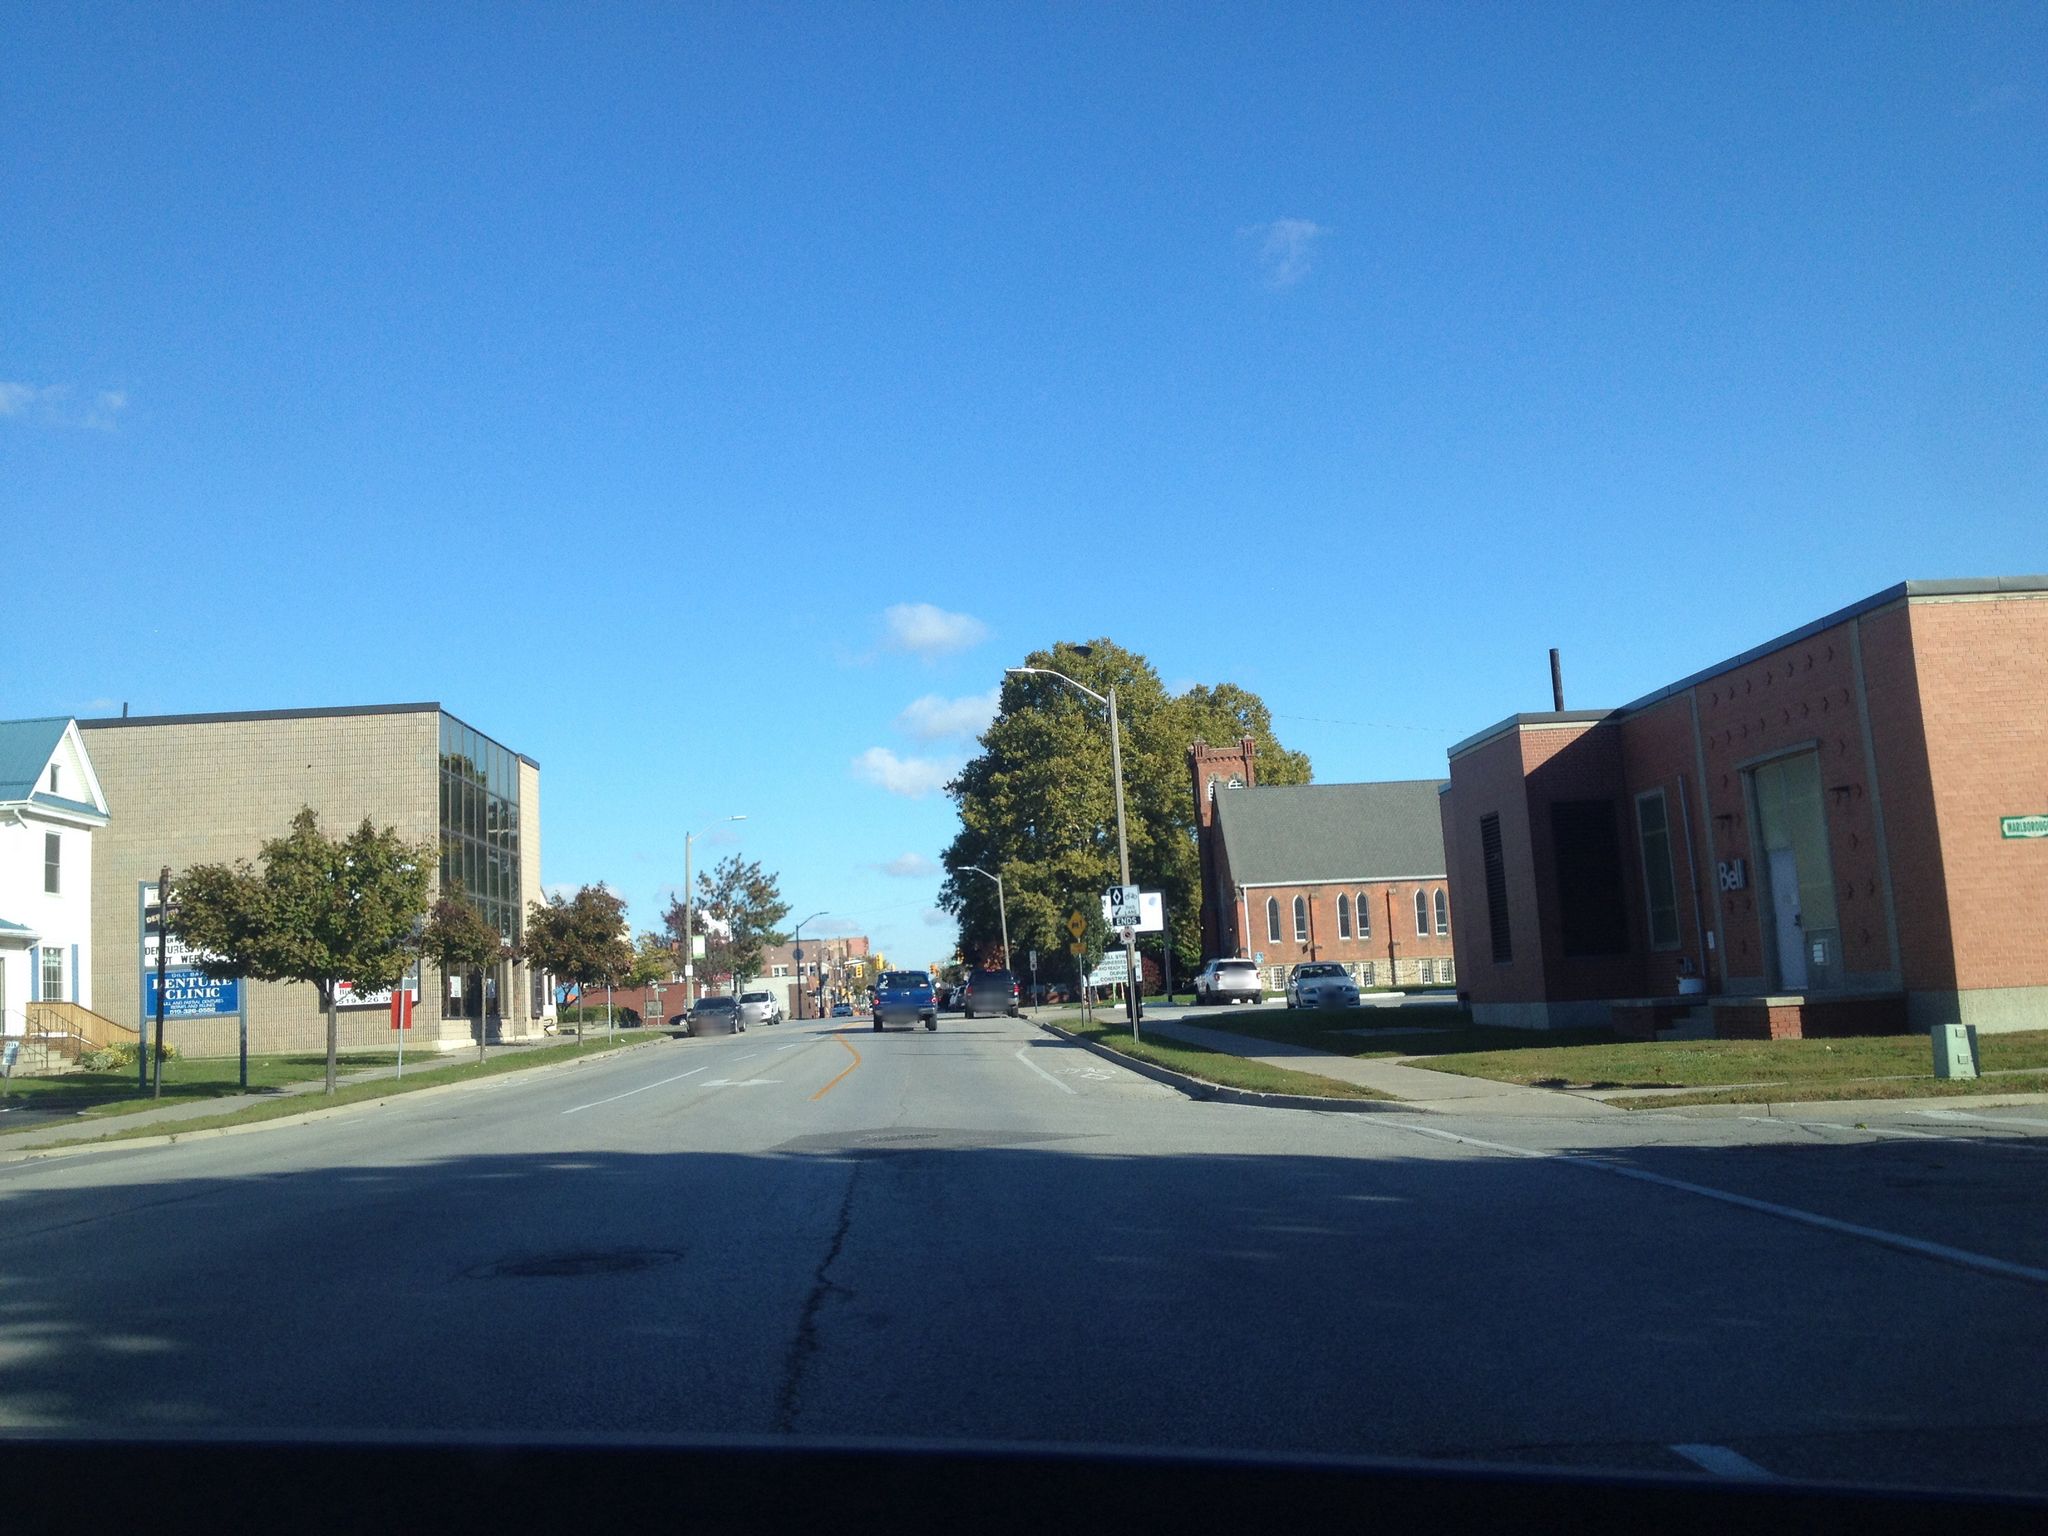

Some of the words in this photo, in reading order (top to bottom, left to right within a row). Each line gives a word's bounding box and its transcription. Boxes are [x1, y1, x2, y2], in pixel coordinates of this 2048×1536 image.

[1718, 857, 1736, 882] Bell
[1116, 916, 1137, 926] ENDS
[145, 946, 190, 956] DENURES
[181, 954, 212, 964] WEES
[165, 987, 220, 1000] CLINIC
